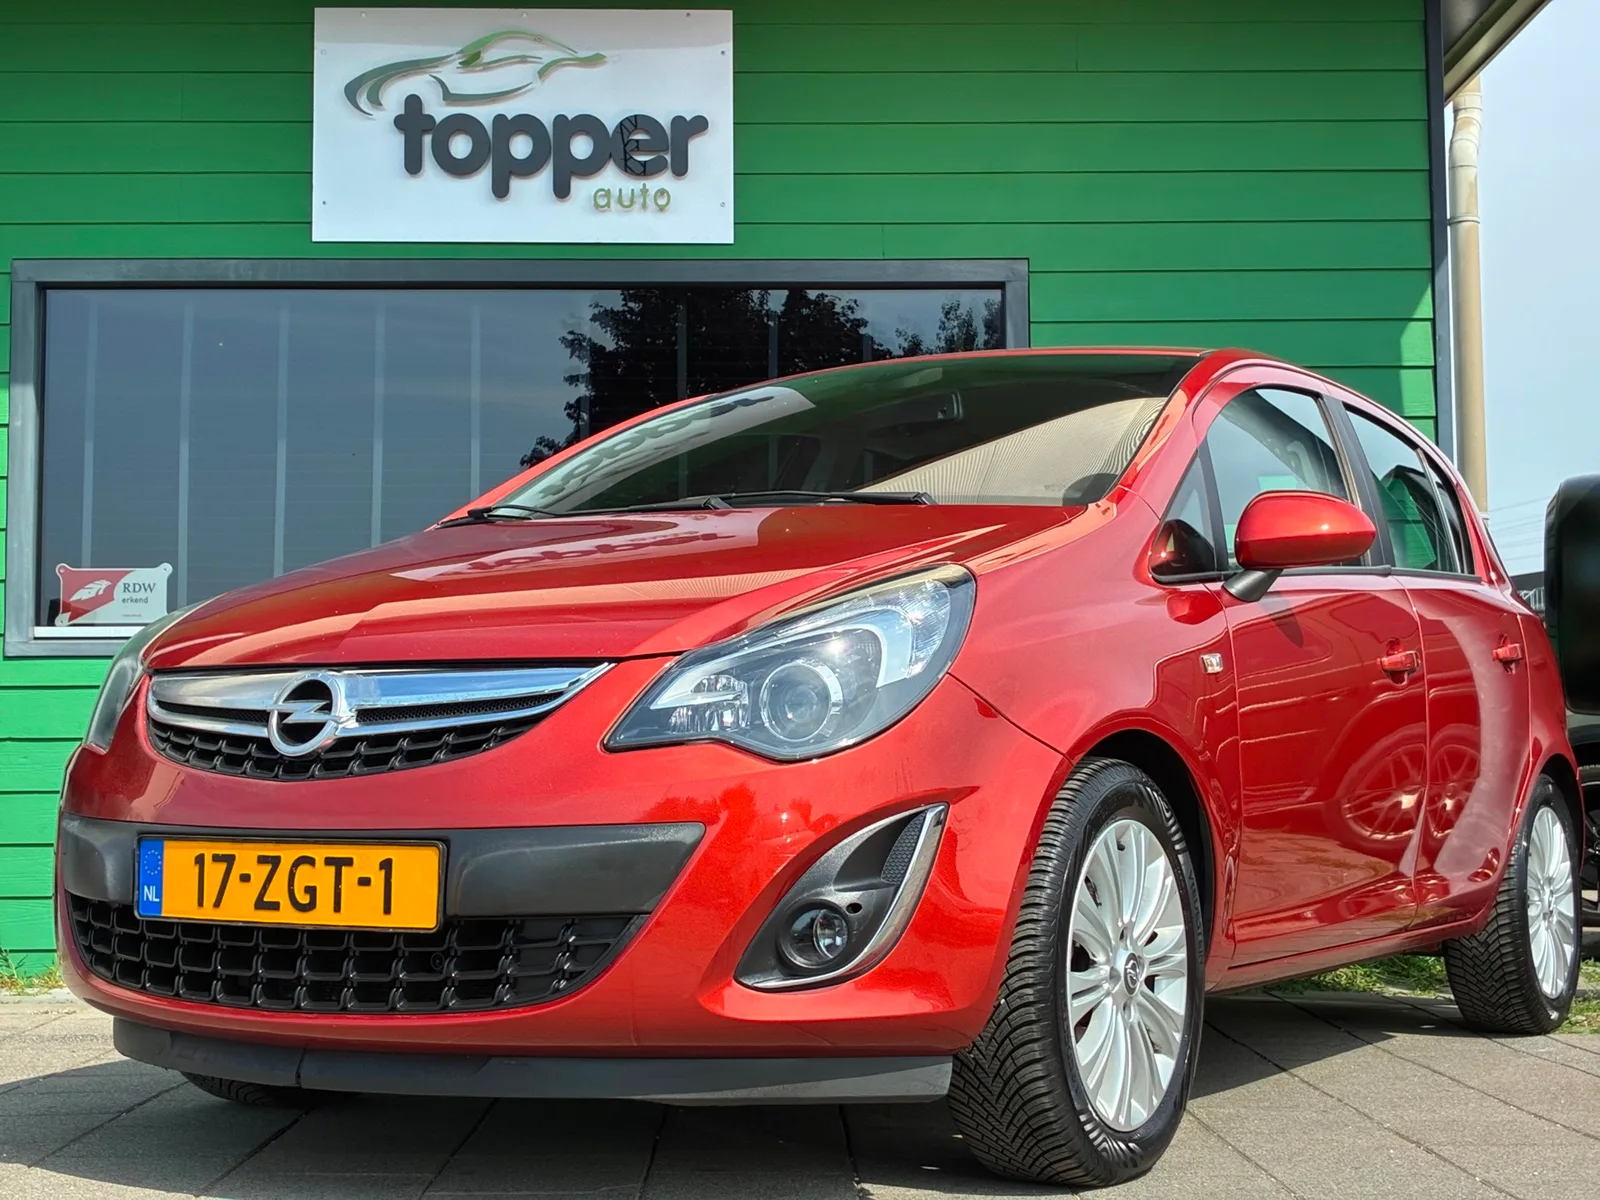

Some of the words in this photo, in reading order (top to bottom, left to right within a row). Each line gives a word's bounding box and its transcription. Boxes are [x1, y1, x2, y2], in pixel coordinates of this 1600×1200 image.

[393, 93, 709, 200] topper
[593, 183, 671, 211] auto
[122, 582, 156, 593] RDW
[121, 596, 149, 604] erkend
[143, 885, 160, 902] NL
[194, 852, 394, 916] 17-ZGT-1
